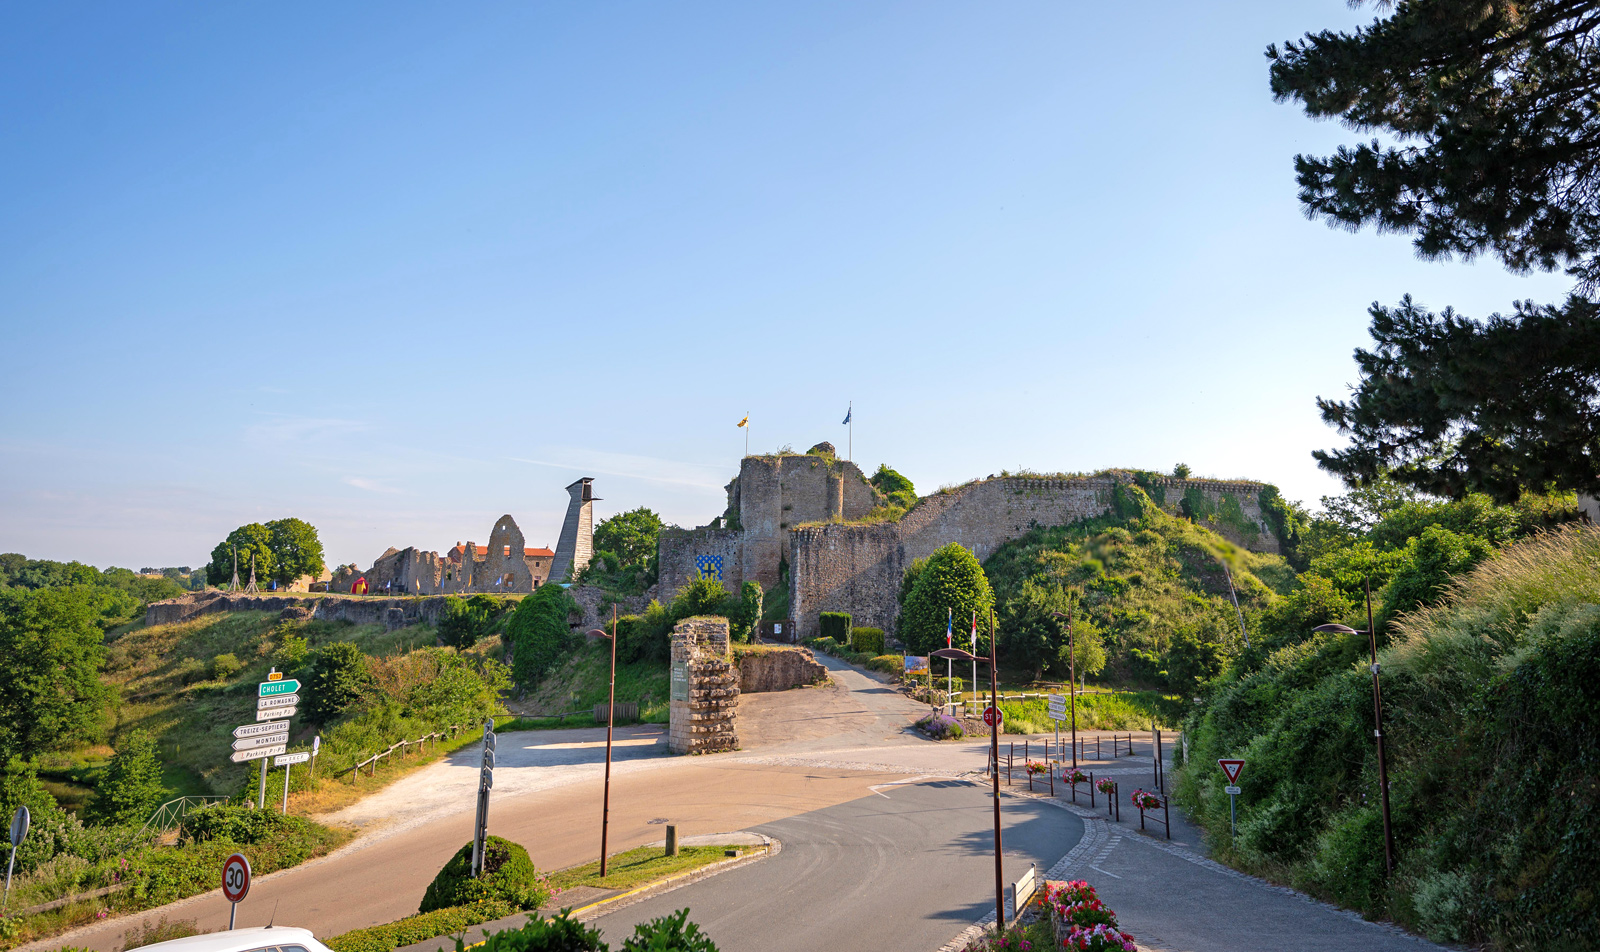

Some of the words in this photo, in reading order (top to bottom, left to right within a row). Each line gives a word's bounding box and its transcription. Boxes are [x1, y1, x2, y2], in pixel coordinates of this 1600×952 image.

[262, 684, 286, 693] CHOLET
[270, 697, 295, 705] ROMAGNE
[985, 713, 1001, 721] STP
[240, 723, 287, 735] TREIZE-SEPTIERS
[255, 736, 286, 744] MONTAIGU
[246, 750, 267, 758] Parking
[226, 867, 244, 890] 30
